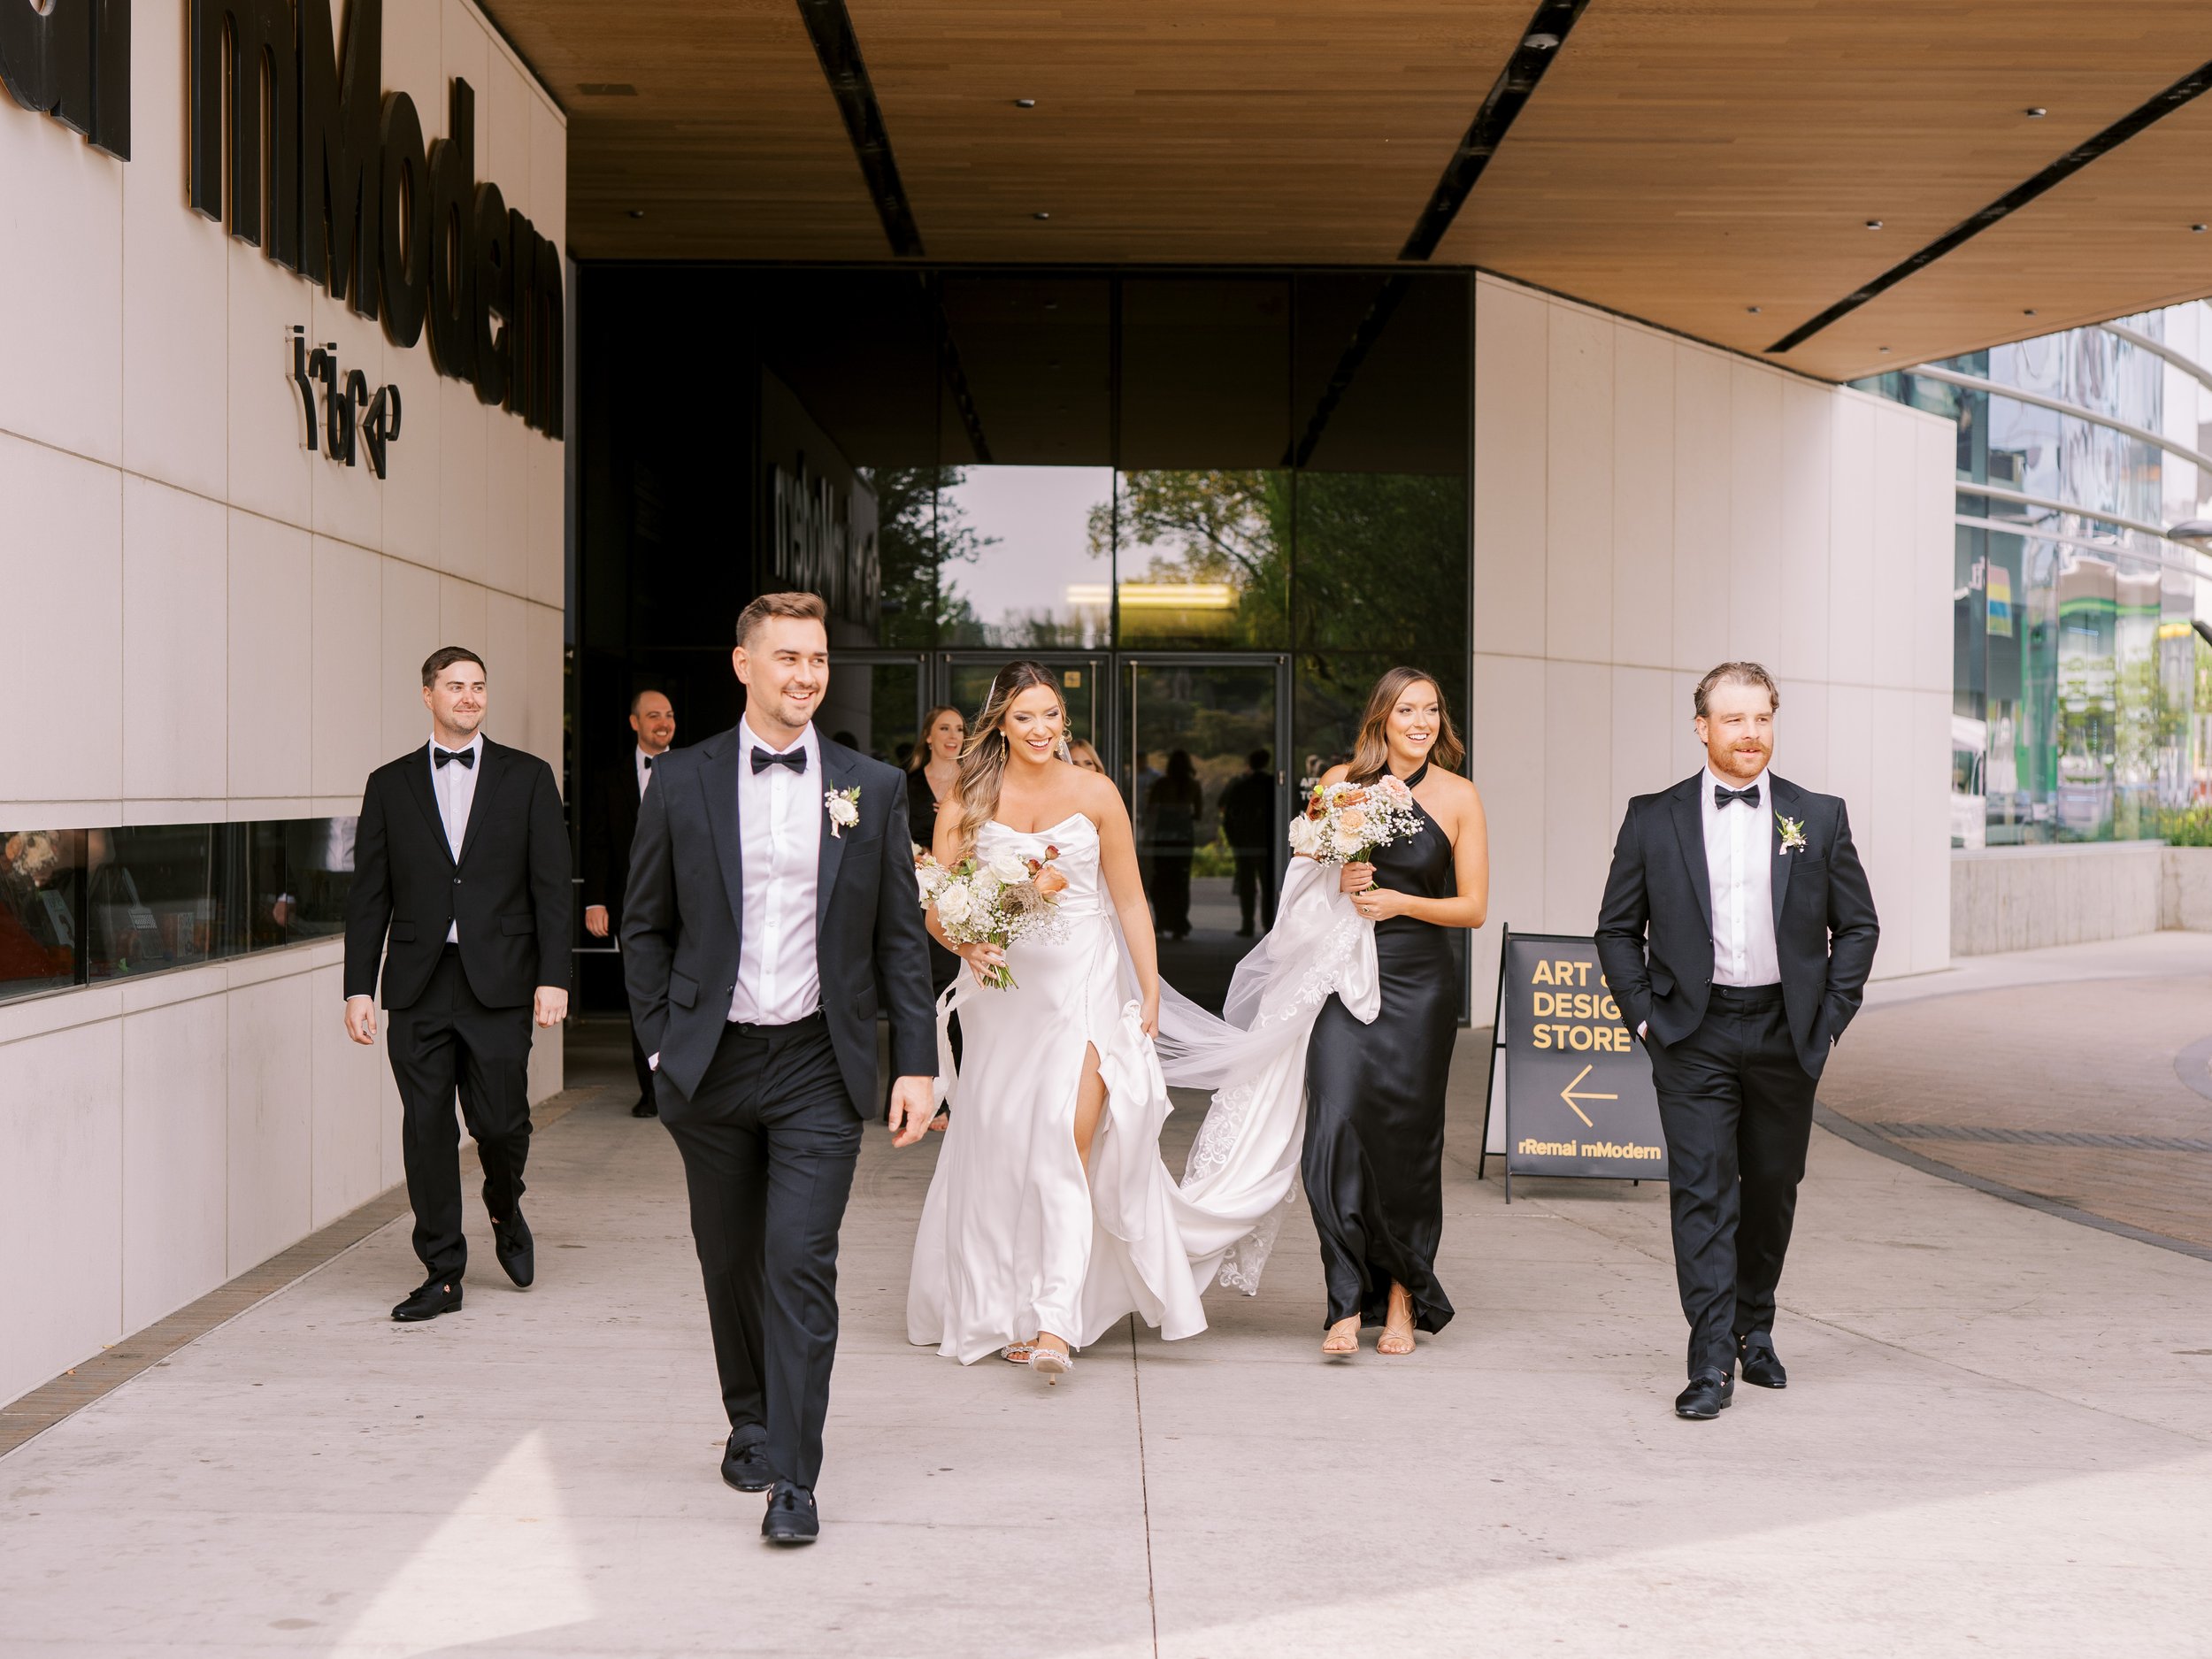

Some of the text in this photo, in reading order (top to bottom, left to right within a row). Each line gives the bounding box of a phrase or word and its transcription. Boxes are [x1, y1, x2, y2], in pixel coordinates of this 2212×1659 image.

[1532, 960, 1592, 986] ART
[1532, 992, 1622, 1020] DESIG
[1532, 1024, 1631, 1052] STORE
[1518, 1138, 1662, 1160] rRemai mModern
